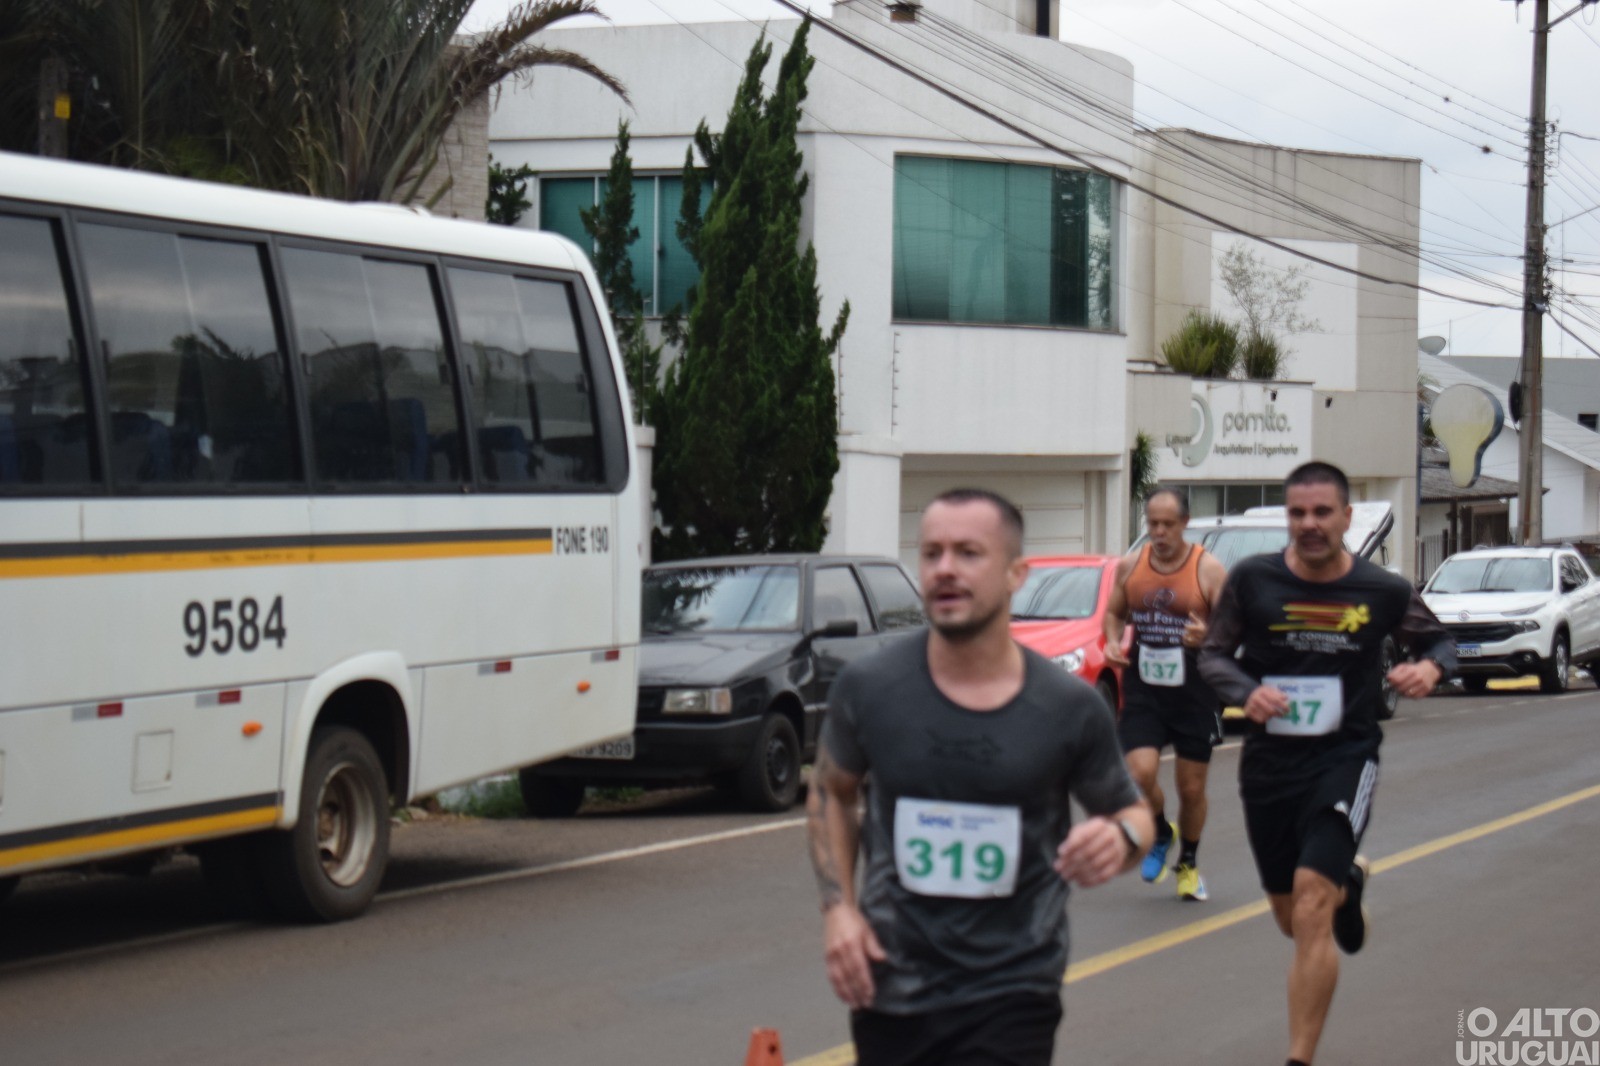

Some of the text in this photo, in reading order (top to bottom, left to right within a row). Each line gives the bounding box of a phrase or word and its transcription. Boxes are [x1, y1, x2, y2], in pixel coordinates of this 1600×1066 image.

[556, 525, 608, 555] FONE 190
[182, 594, 286, 658] 9584
[1142, 660, 1178, 680] 137
[905, 837, 1006, 882] 319
